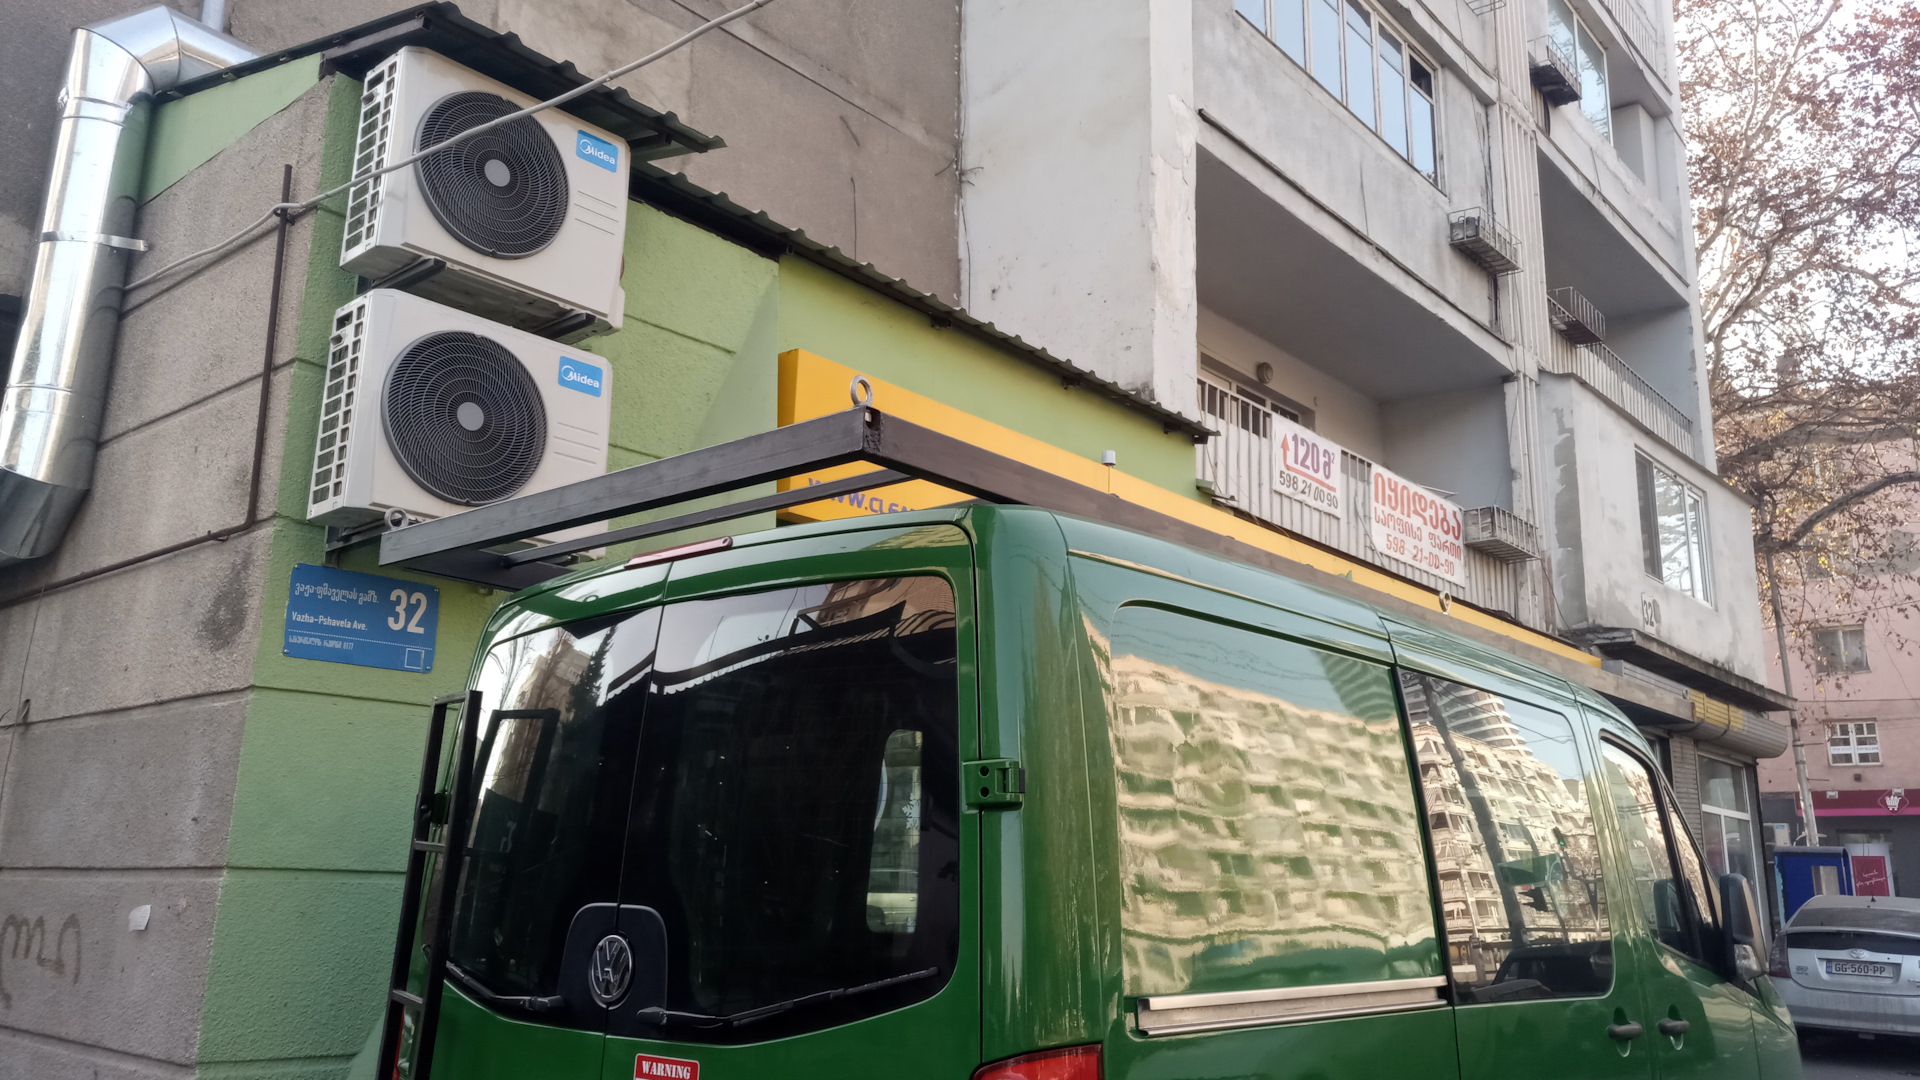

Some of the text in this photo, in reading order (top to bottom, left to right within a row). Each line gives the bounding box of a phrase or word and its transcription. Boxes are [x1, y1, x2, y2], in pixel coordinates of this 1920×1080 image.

[580, 139, 615, 165] Midea
[562, 365, 600, 388] Midea
[1279, 470, 1298, 491] 598
[1374, 472, 1462, 541] იყიდება
[1374, 506, 1462, 562] საოფისე ფართი
[1386, 533, 1406, 555] 598
[294, 582, 358, 603] ვაჟა-ფშაველას
[292, 611, 368, 631] Vazha-Pshavela Ave.
[387, 588, 427, 635] 32
[1834, 963, 1886, 975] GG-560-PP
[641, 1060, 691, 1080] WARNING
